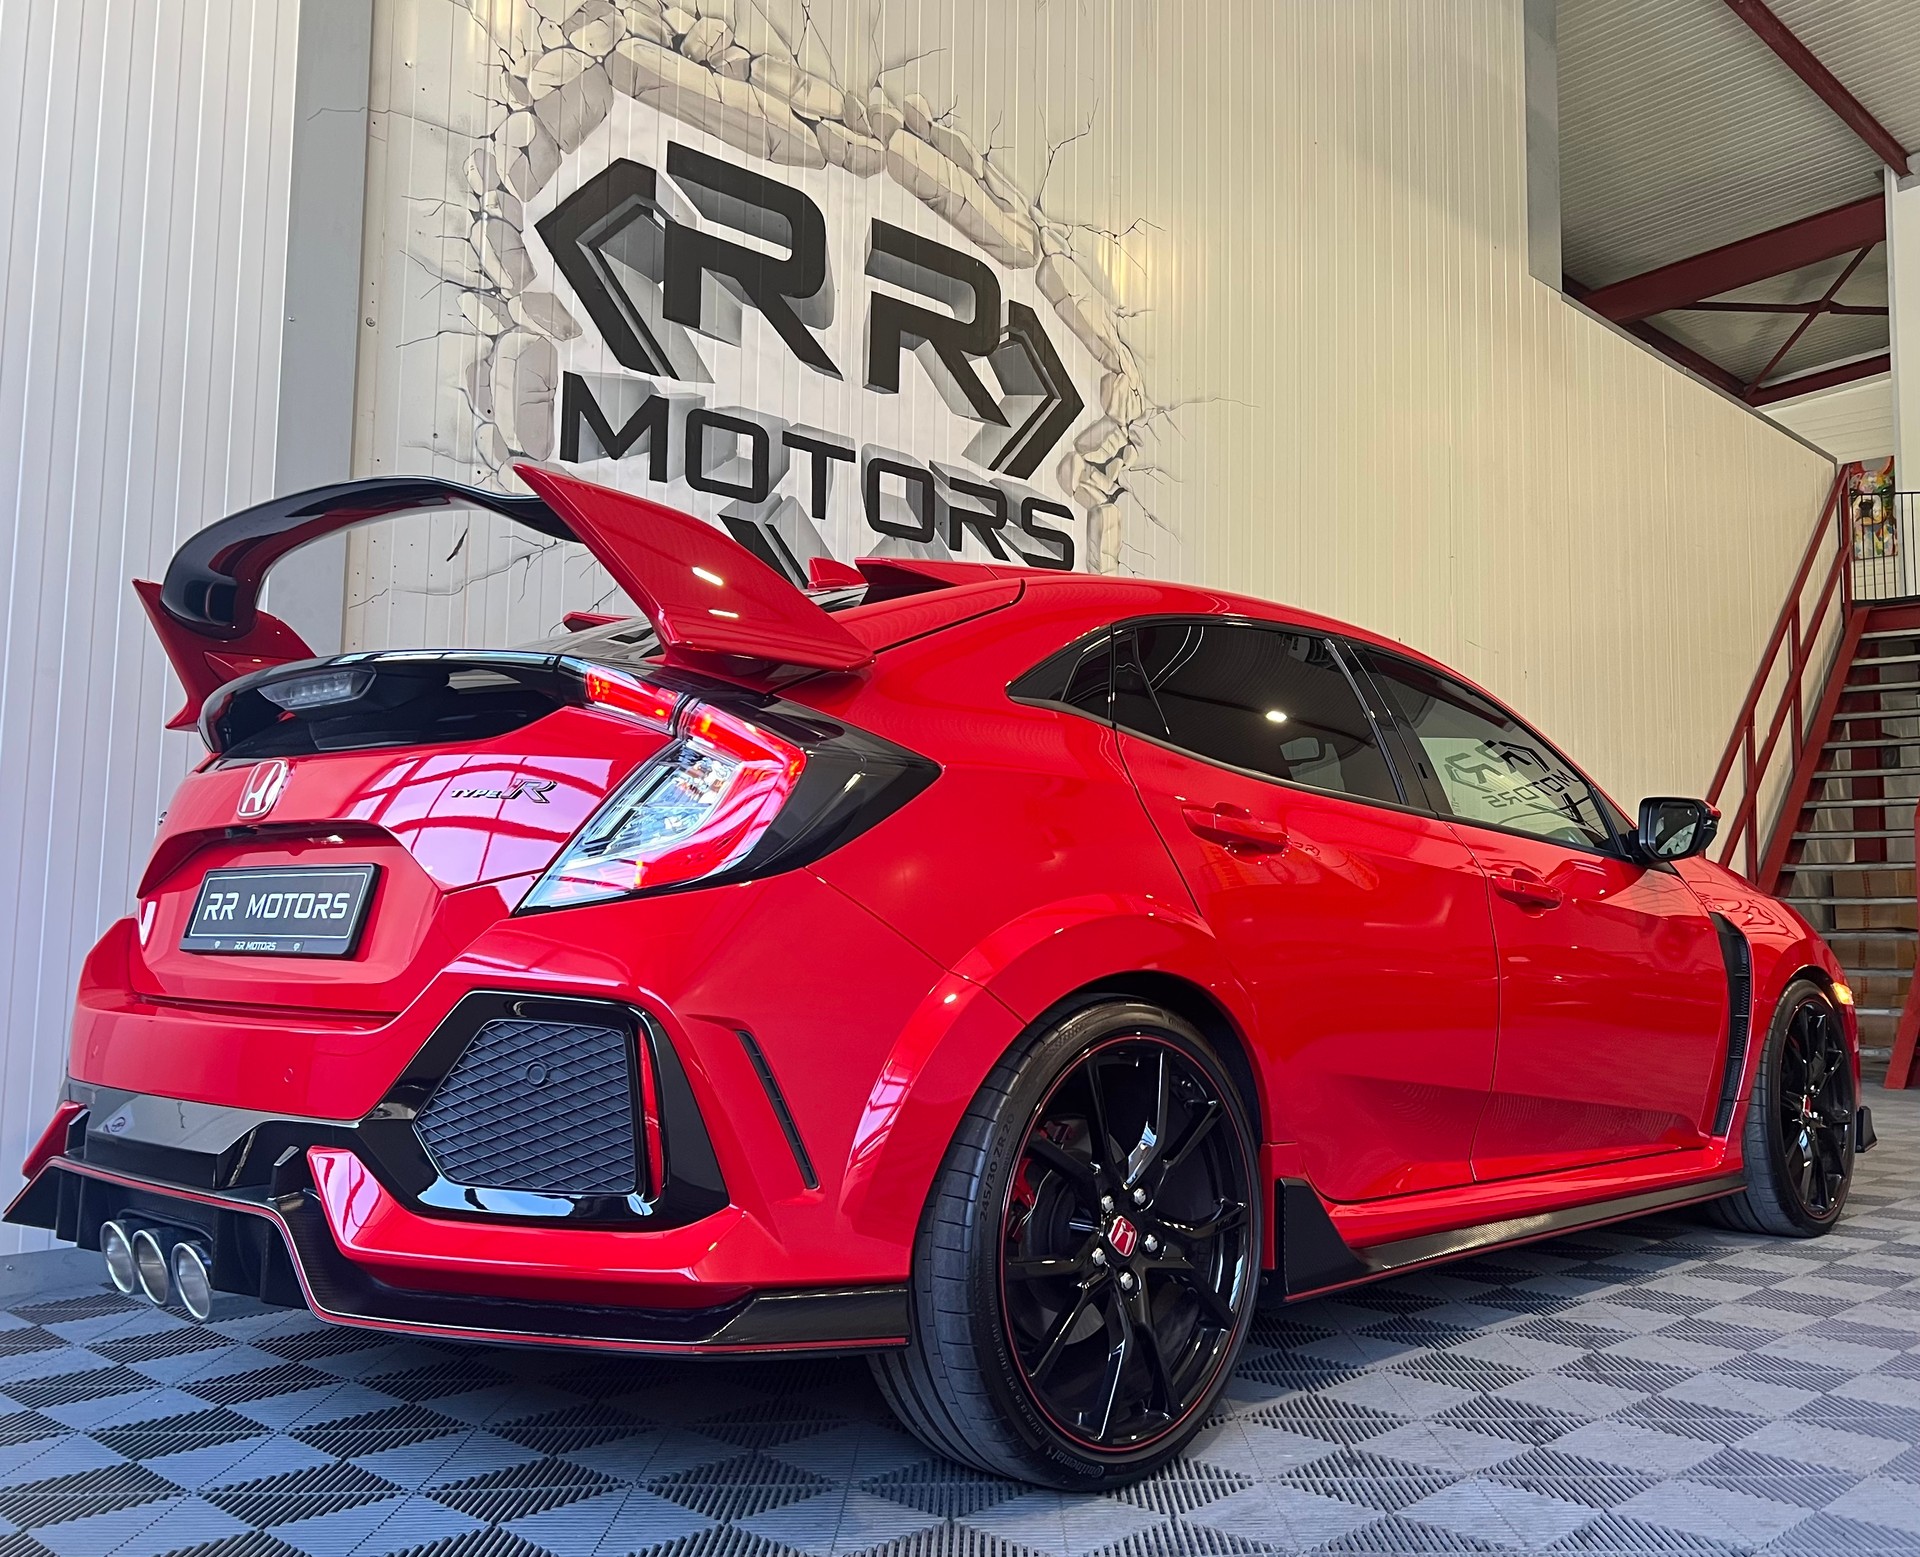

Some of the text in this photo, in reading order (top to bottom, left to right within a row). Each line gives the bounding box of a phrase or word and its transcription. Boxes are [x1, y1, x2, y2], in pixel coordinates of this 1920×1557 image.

[662, 141, 1012, 428] RR
[559, 370, 1076, 571] MOTORS
[451, 778, 558, 804] TYPE R
[202, 892, 351, 921] RR MOTORS
[233, 941, 277, 951] RR MOTORS
[980, 1161, 998, 1221] 245/30
[993, 1137, 1006, 1158] ZR
[1002, 1113, 1015, 1134] 20
[1051, 1449, 1105, 1478] Continental
